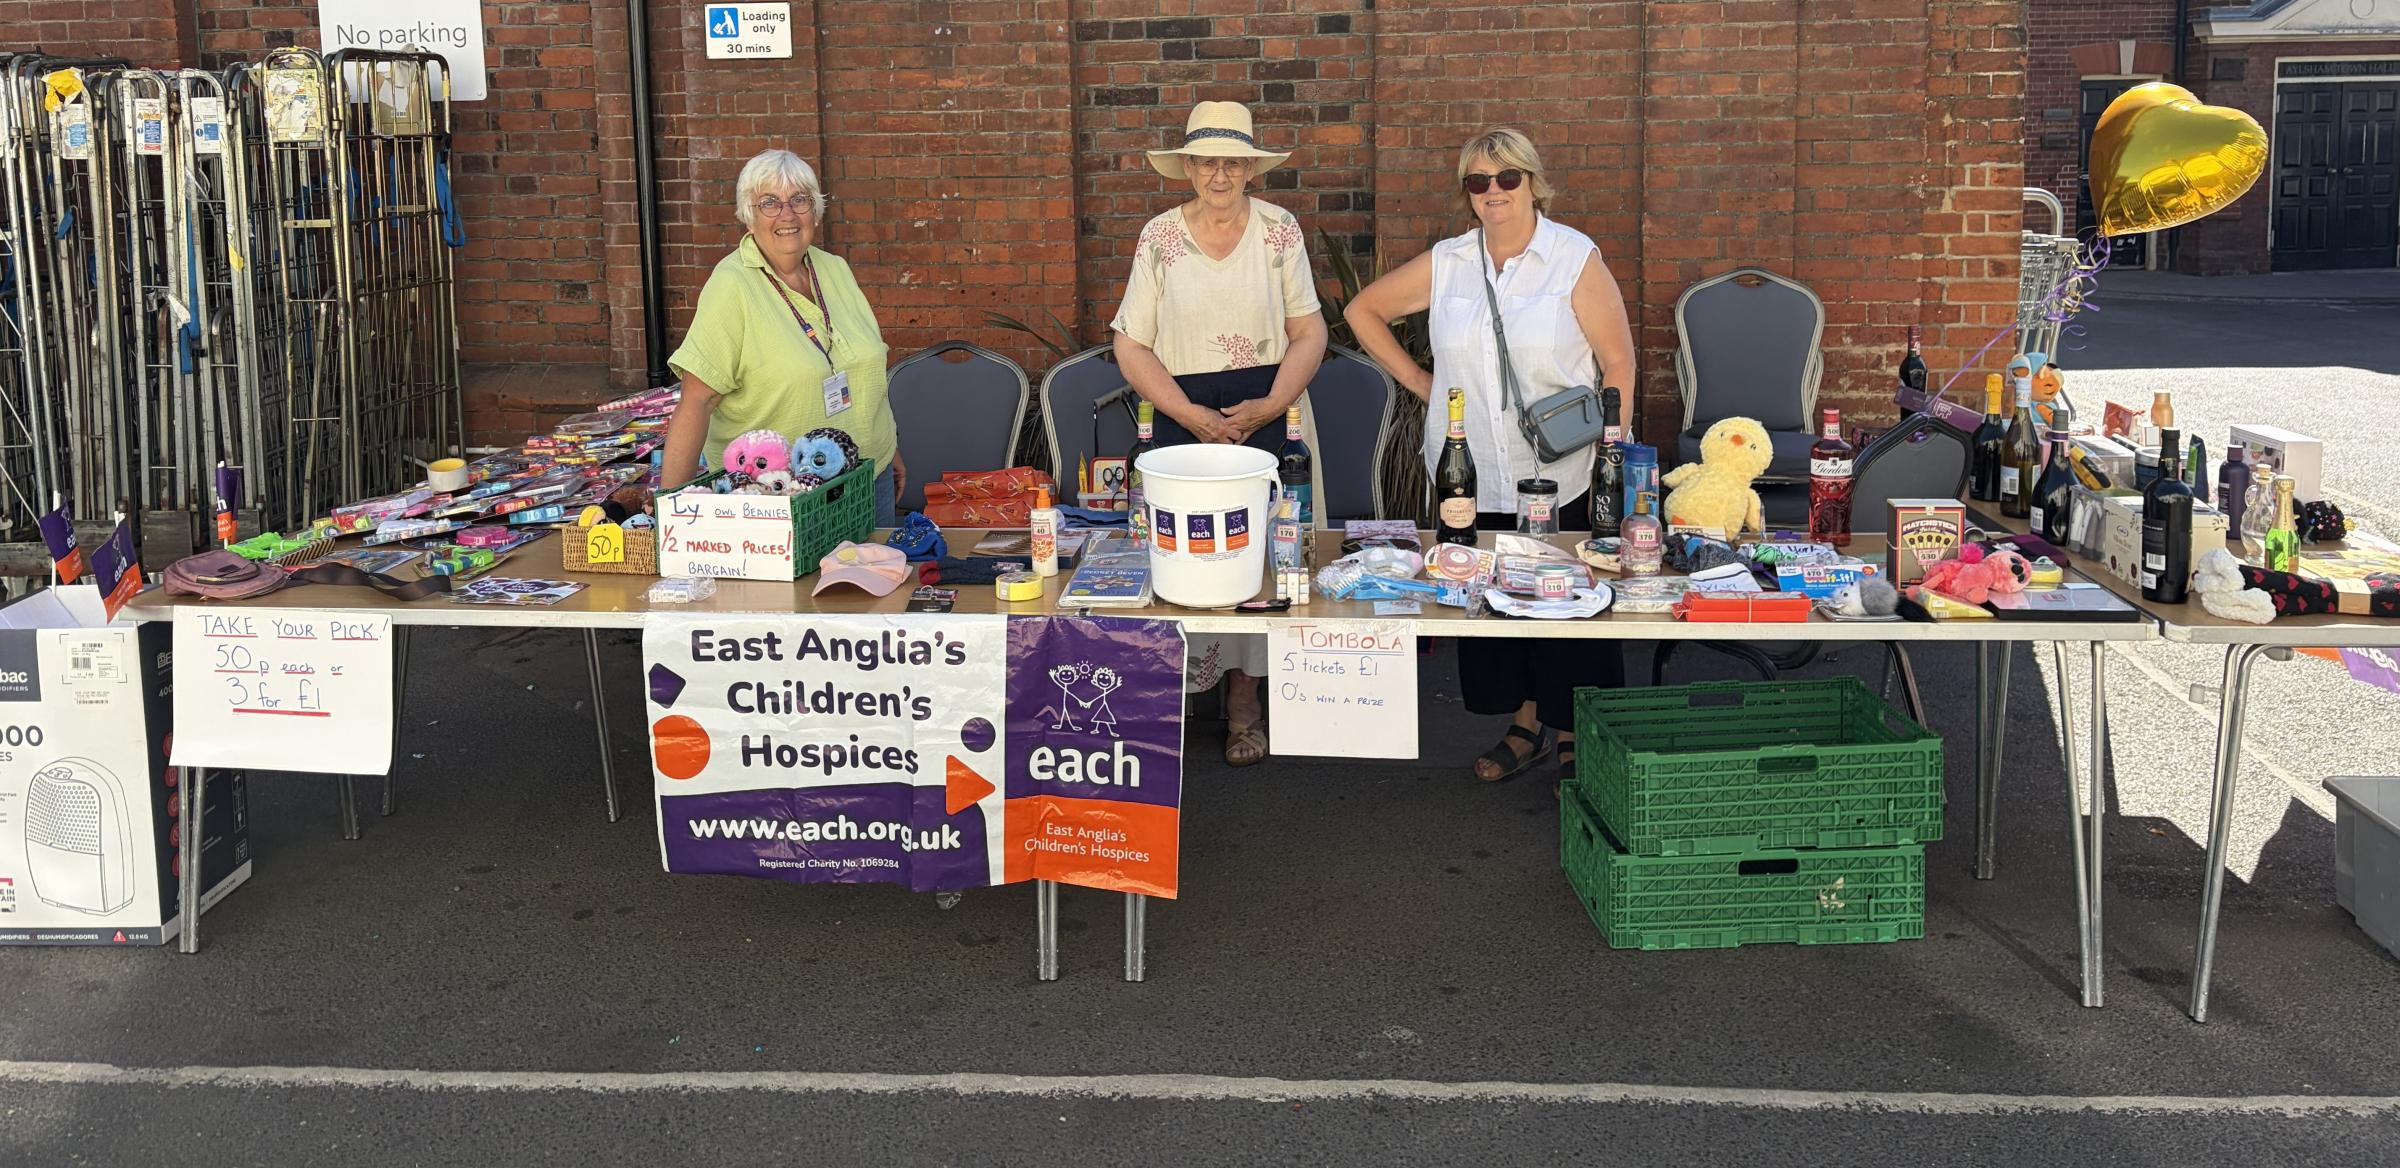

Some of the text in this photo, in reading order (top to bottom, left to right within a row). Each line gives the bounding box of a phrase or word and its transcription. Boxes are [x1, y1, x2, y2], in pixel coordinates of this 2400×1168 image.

[742, 11, 786, 21] Loading
[752, 23, 776, 34] only
[336, 20, 467, 49] No parking
[726, 43, 772, 53] 30 mins
[714, 508, 736, 516] OWL
[743, 502, 790, 519] BEANIES
[1157, 526, 1173, 536] each
[1190, 529, 1211, 539] each
[1228, 524, 1246, 535] each
[590, 534, 621, 561] 50p
[686, 540, 732, 554] MARKED
[742, 530, 792, 562] PRICES!
[688, 558, 747, 577] BARGAIN!
[197, 614, 390, 640] TAKE YOUR PICK!
[1290, 625, 1404, 650] TOMBOLA
[691, 628, 967, 671] East Anglia's
[280, 663, 316, 674] each
[1281, 652, 1378, 677] 5 tickets £1
[226, 677, 322, 710] 3 for £1
[727, 679, 932, 721] Children's
[1316, 696, 1336, 704] WIN
[1357, 697, 1384, 706] PRIZE
[741, 734, 919, 776] Hospices
[1029, 740, 1141, 787] each
[688, 814, 961, 852] www.each.org.uk
[1046, 823, 1127, 844] East Anglia's
[1024, 838, 1150, 863] Children's Hospices
[759, 858, 899, 869] Registered Charity No. 1069284
